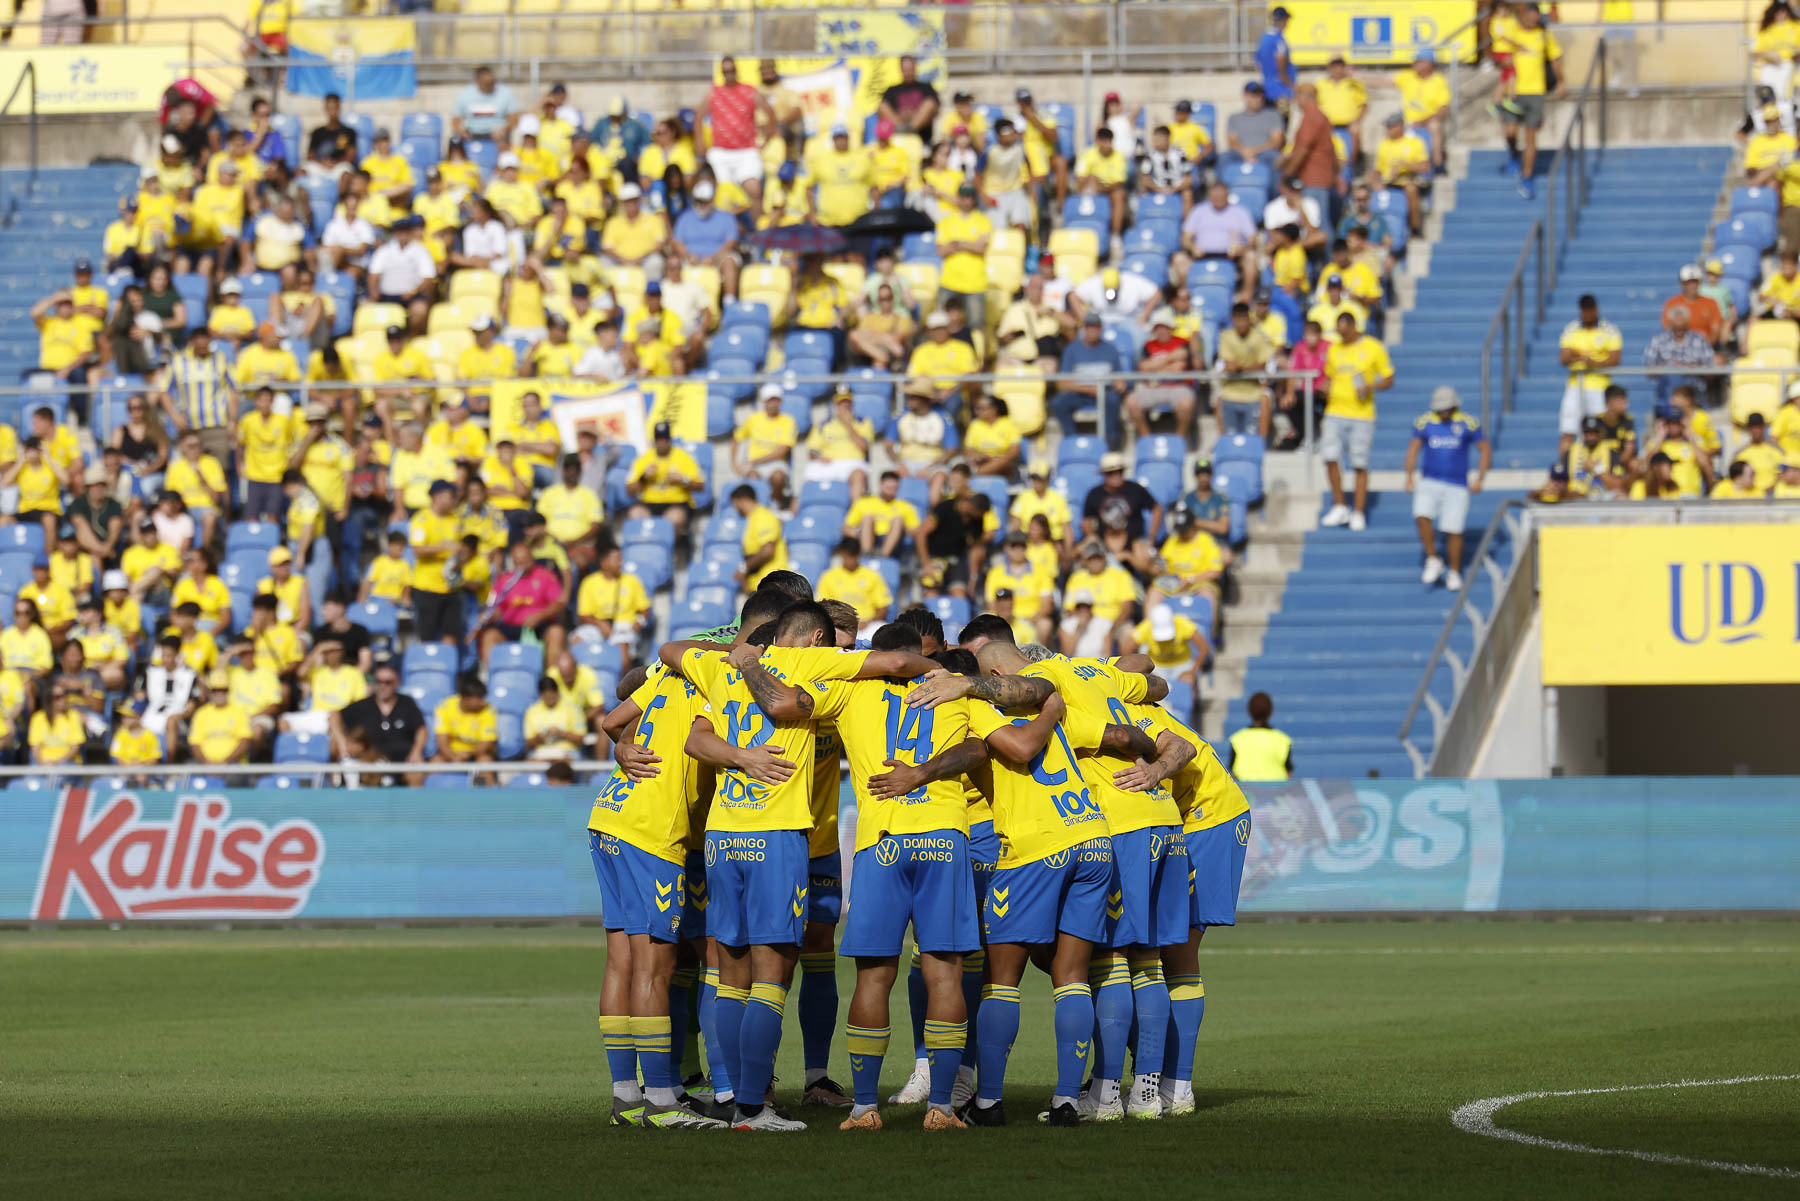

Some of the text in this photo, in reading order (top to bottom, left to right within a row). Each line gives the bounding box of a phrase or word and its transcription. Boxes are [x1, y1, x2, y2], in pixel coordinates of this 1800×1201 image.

[636, 695, 667, 748] 5
[882, 689, 934, 763] 14
[722, 700, 776, 778] 12
[1050, 787, 1101, 818] IOC
[31, 787, 324, 919] Kalise
[719, 838, 767, 850] DOMINGO
[903, 838, 954, 850] DOMINGO
[910, 851, 953, 862] AONSO
[677, 873, 686, 907] 5
